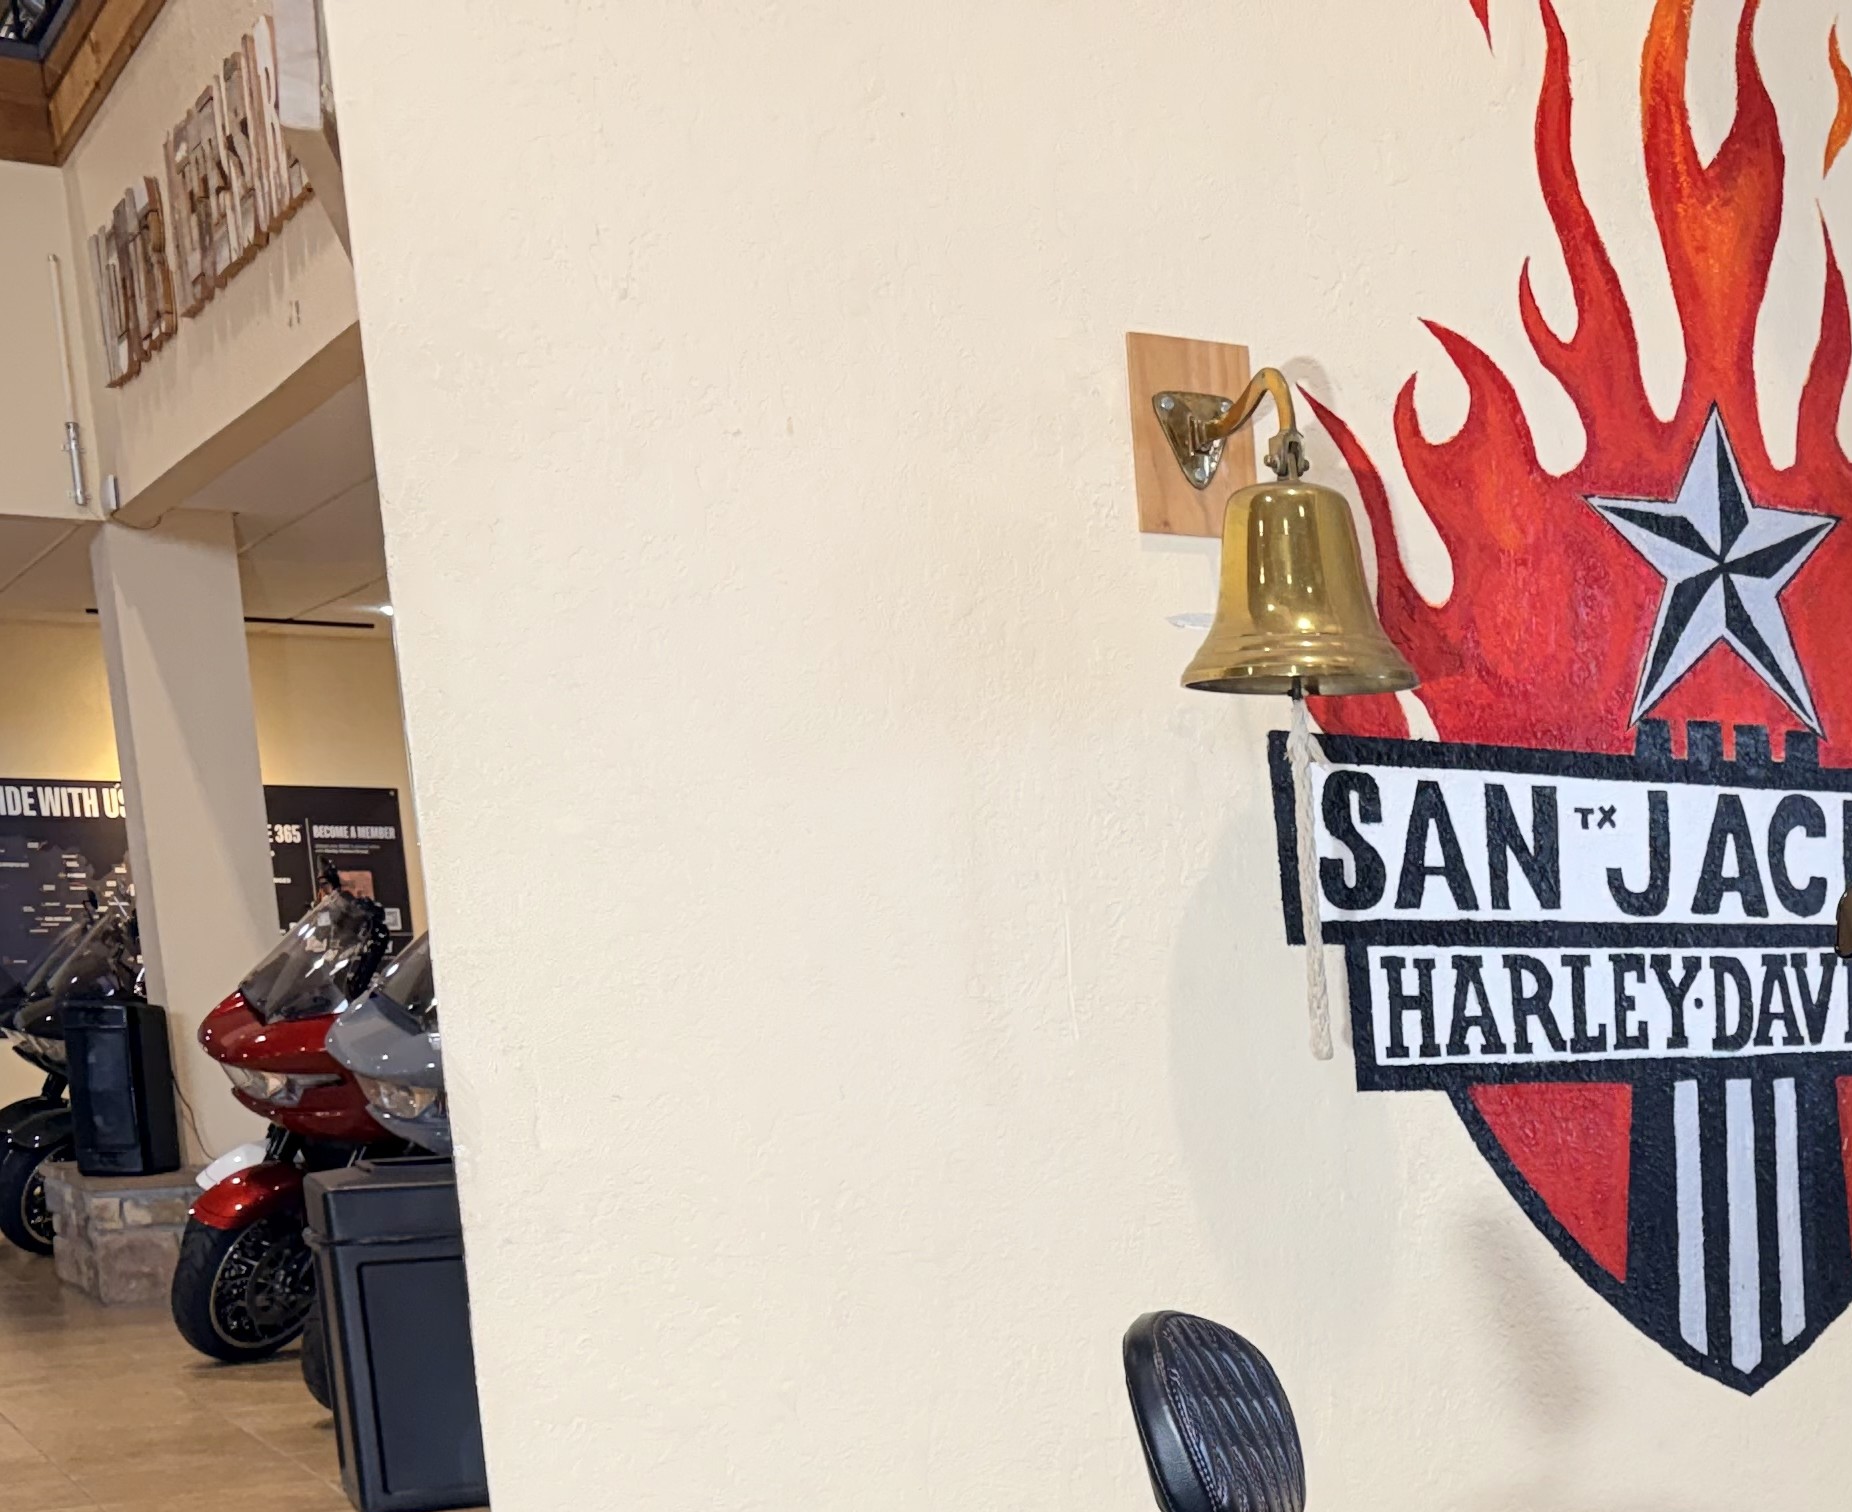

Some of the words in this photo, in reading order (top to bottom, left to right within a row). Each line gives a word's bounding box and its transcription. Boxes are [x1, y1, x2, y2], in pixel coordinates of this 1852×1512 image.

[37, 785, 100, 818] WITH
[275, 824, 302, 844] 365
[312, 825, 349, 840] BECOME
[350, 825, 357, 839] A
[357, 825, 396, 840] MEMBER
[1319, 769, 1561, 911] SAN
[1573, 804, 1617, 830] TX
